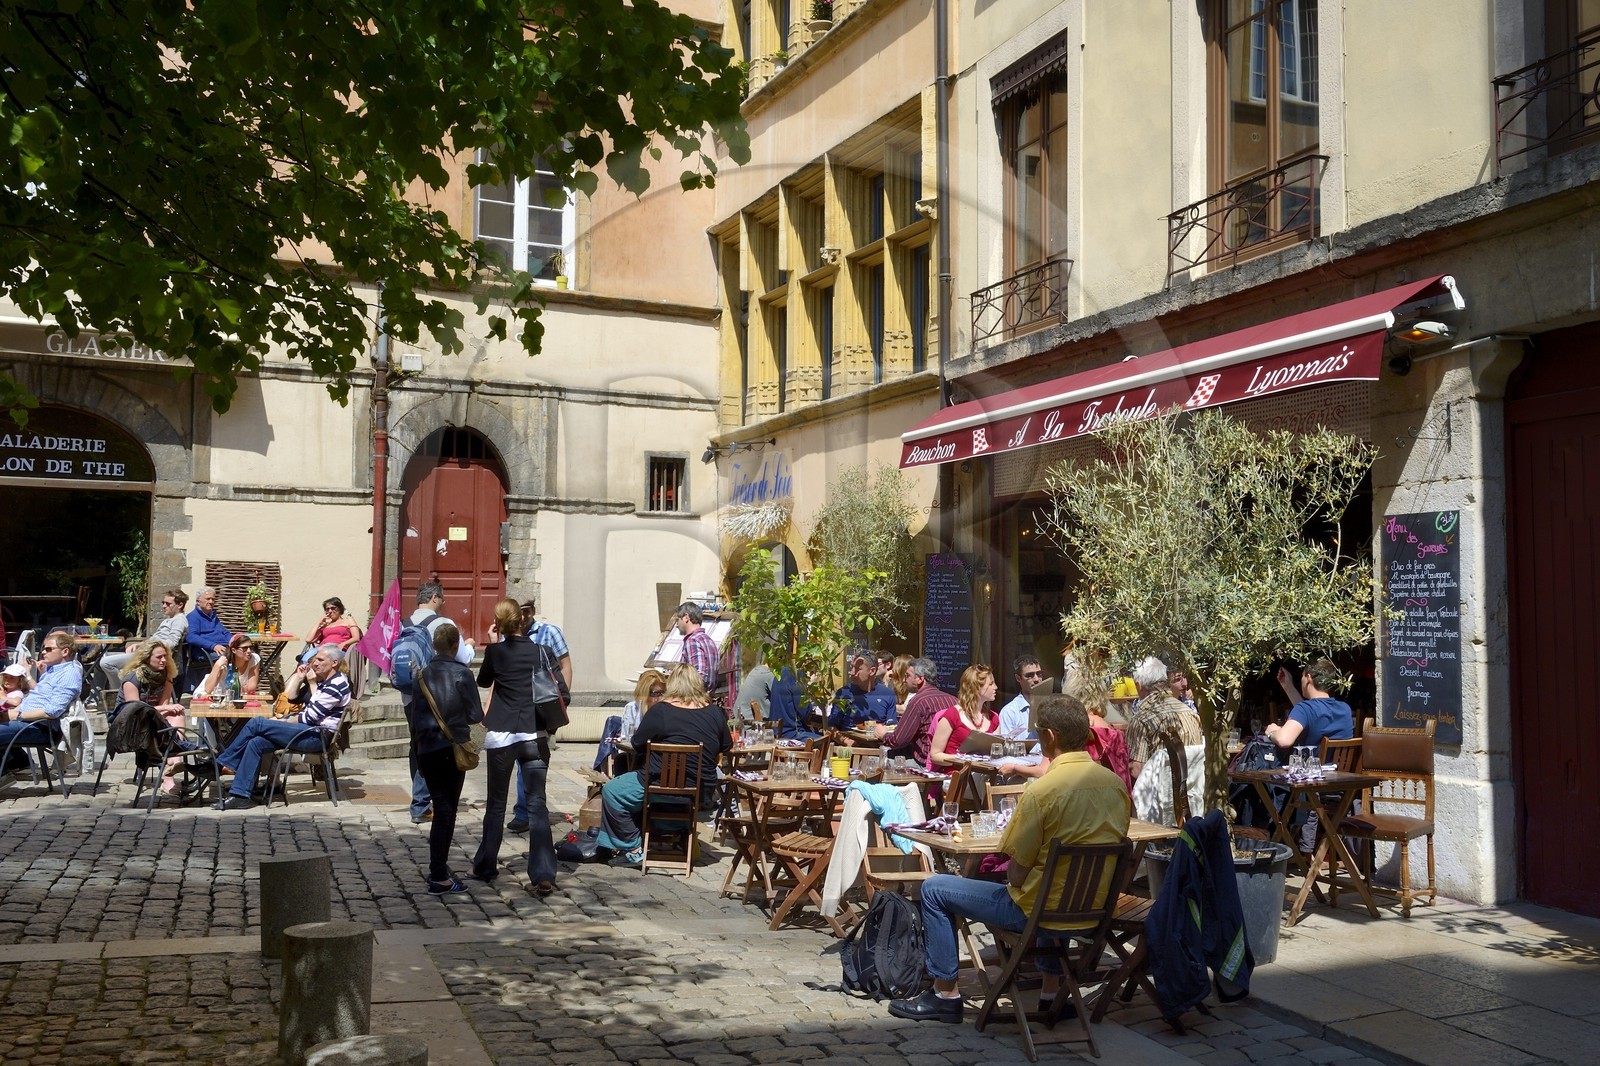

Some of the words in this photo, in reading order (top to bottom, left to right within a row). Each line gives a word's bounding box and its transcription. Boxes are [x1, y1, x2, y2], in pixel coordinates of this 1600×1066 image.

[905, 440, 956, 464] Bouchon
[1008, 417, 1032, 447] A
[1039, 410, 1065, 441] La
[1078, 389, 1157, 433] Traboule
[1244, 345, 1355, 395] Lyonnais
[45, 459, 73, 474] DE
[82, 461, 125, 477] THE
[1386, 516, 1408, 542] Menu
